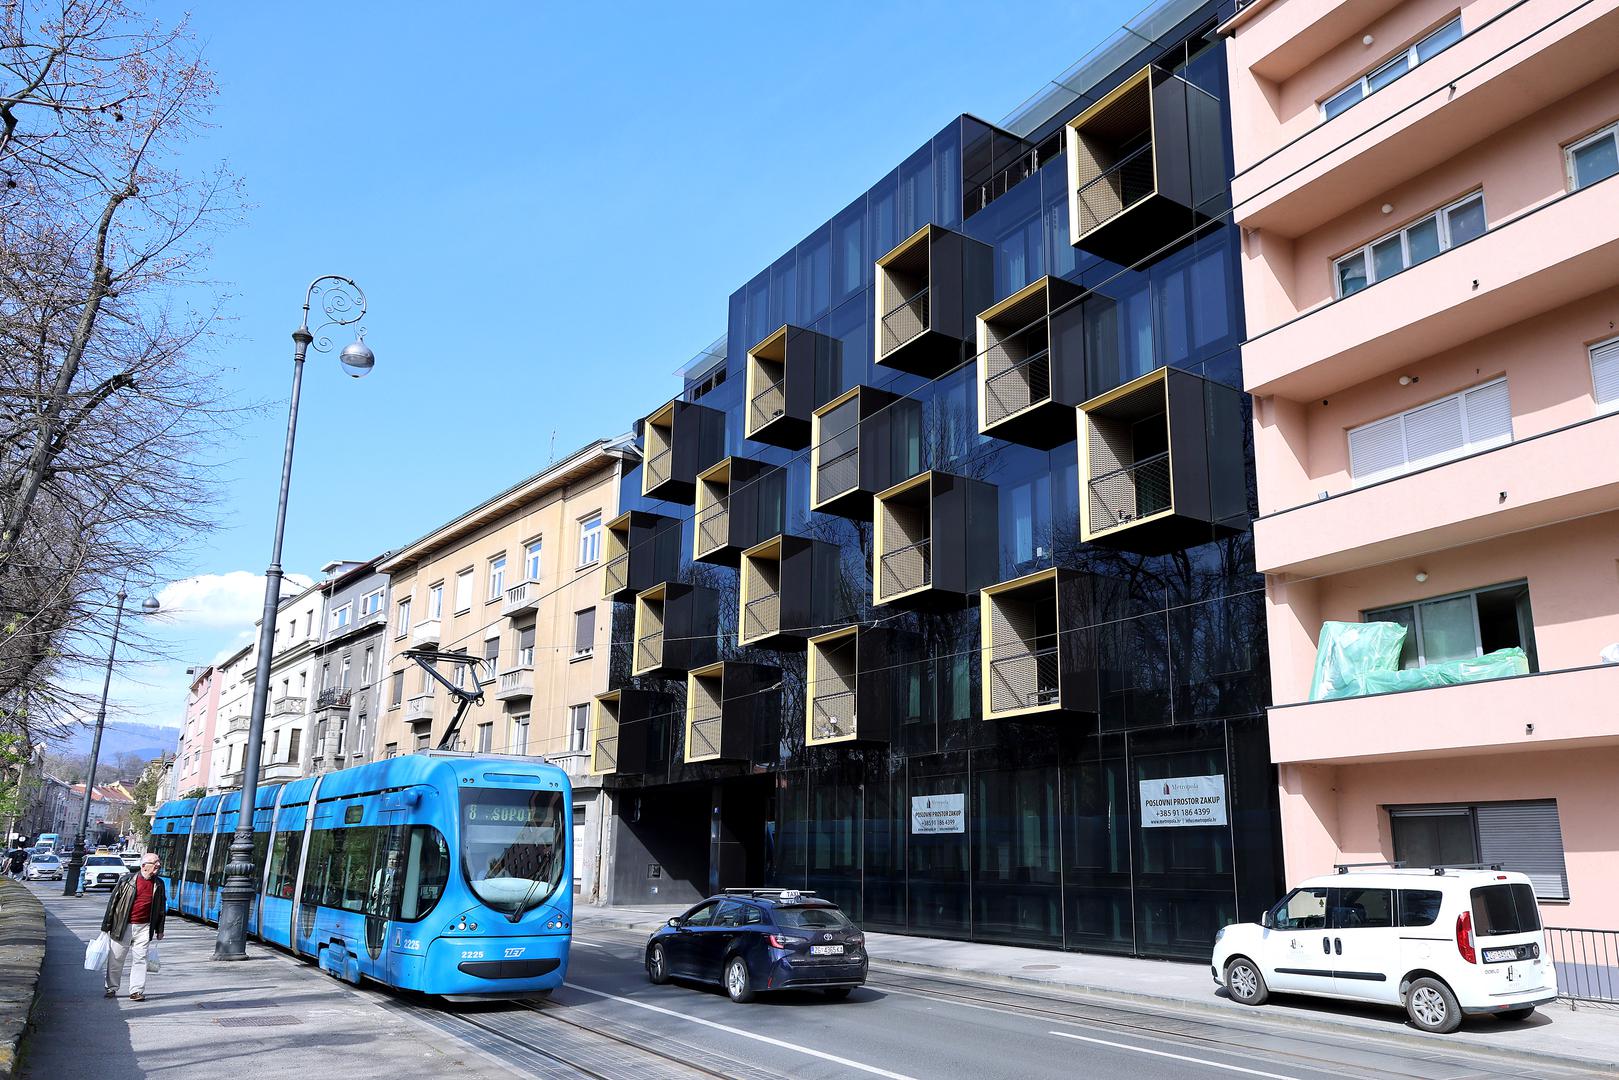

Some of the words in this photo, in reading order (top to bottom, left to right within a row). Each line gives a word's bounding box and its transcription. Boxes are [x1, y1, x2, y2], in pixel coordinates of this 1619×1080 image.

[1145, 799, 1173, 807] POSLOVNI
[1173, 797, 1199, 805] PROSTOR
[1199, 796, 1221, 804] ZAKUP
[1156, 809, 1171, 817] +385
[1173, 809, 1180, 817] 91
[1182, 808, 1193, 816] 186
[1194, 808, 1211, 816] 4399
[404, 940, 420, 950] 2225
[461, 951, 485, 959] 2225
